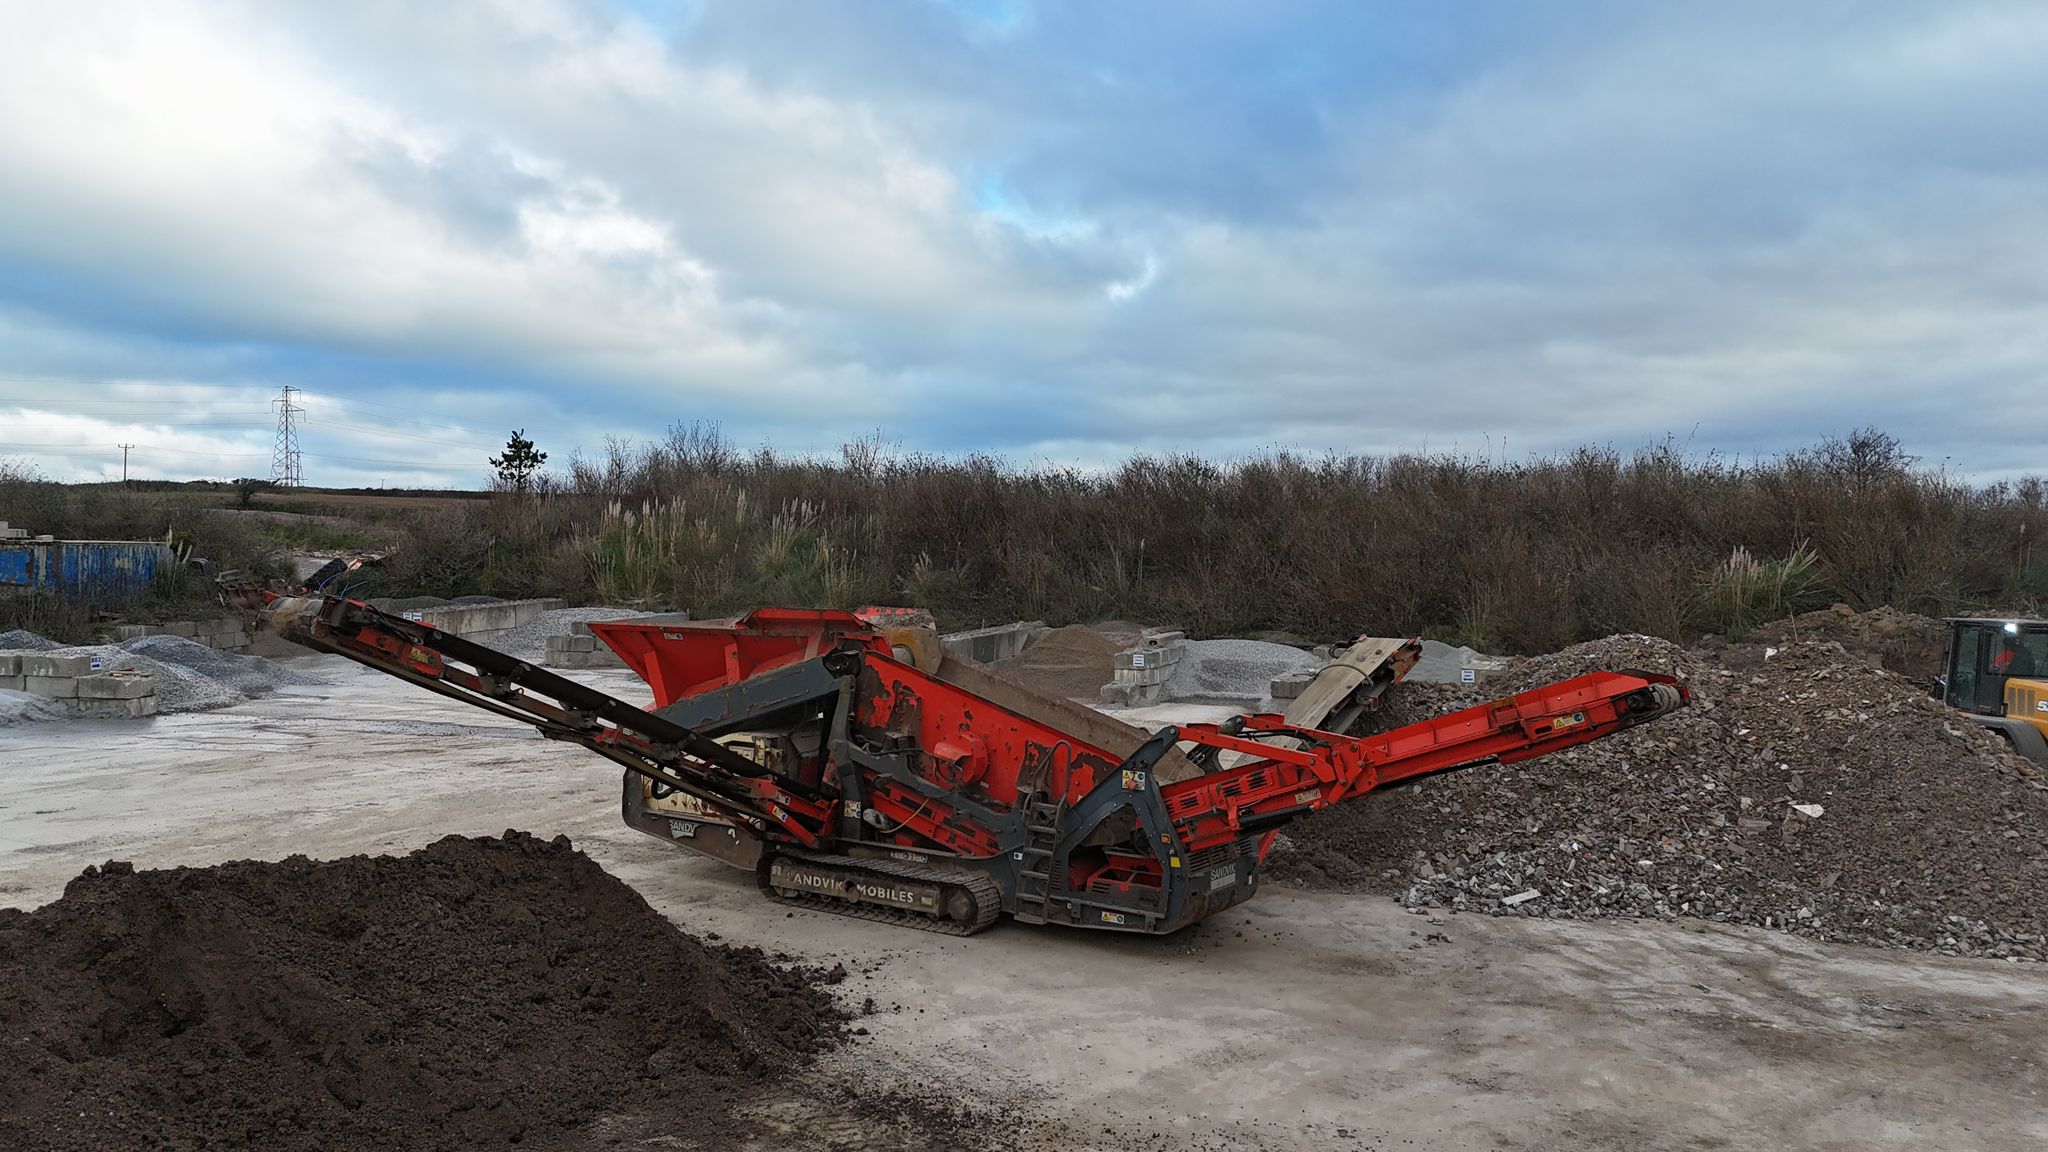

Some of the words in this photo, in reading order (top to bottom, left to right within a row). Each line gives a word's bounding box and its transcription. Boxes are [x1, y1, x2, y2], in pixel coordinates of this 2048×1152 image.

[2036, 700, 2048, 712] 5
[786, 872, 844, 890] ANDVIK
[856, 883, 914, 903] MOBILES
